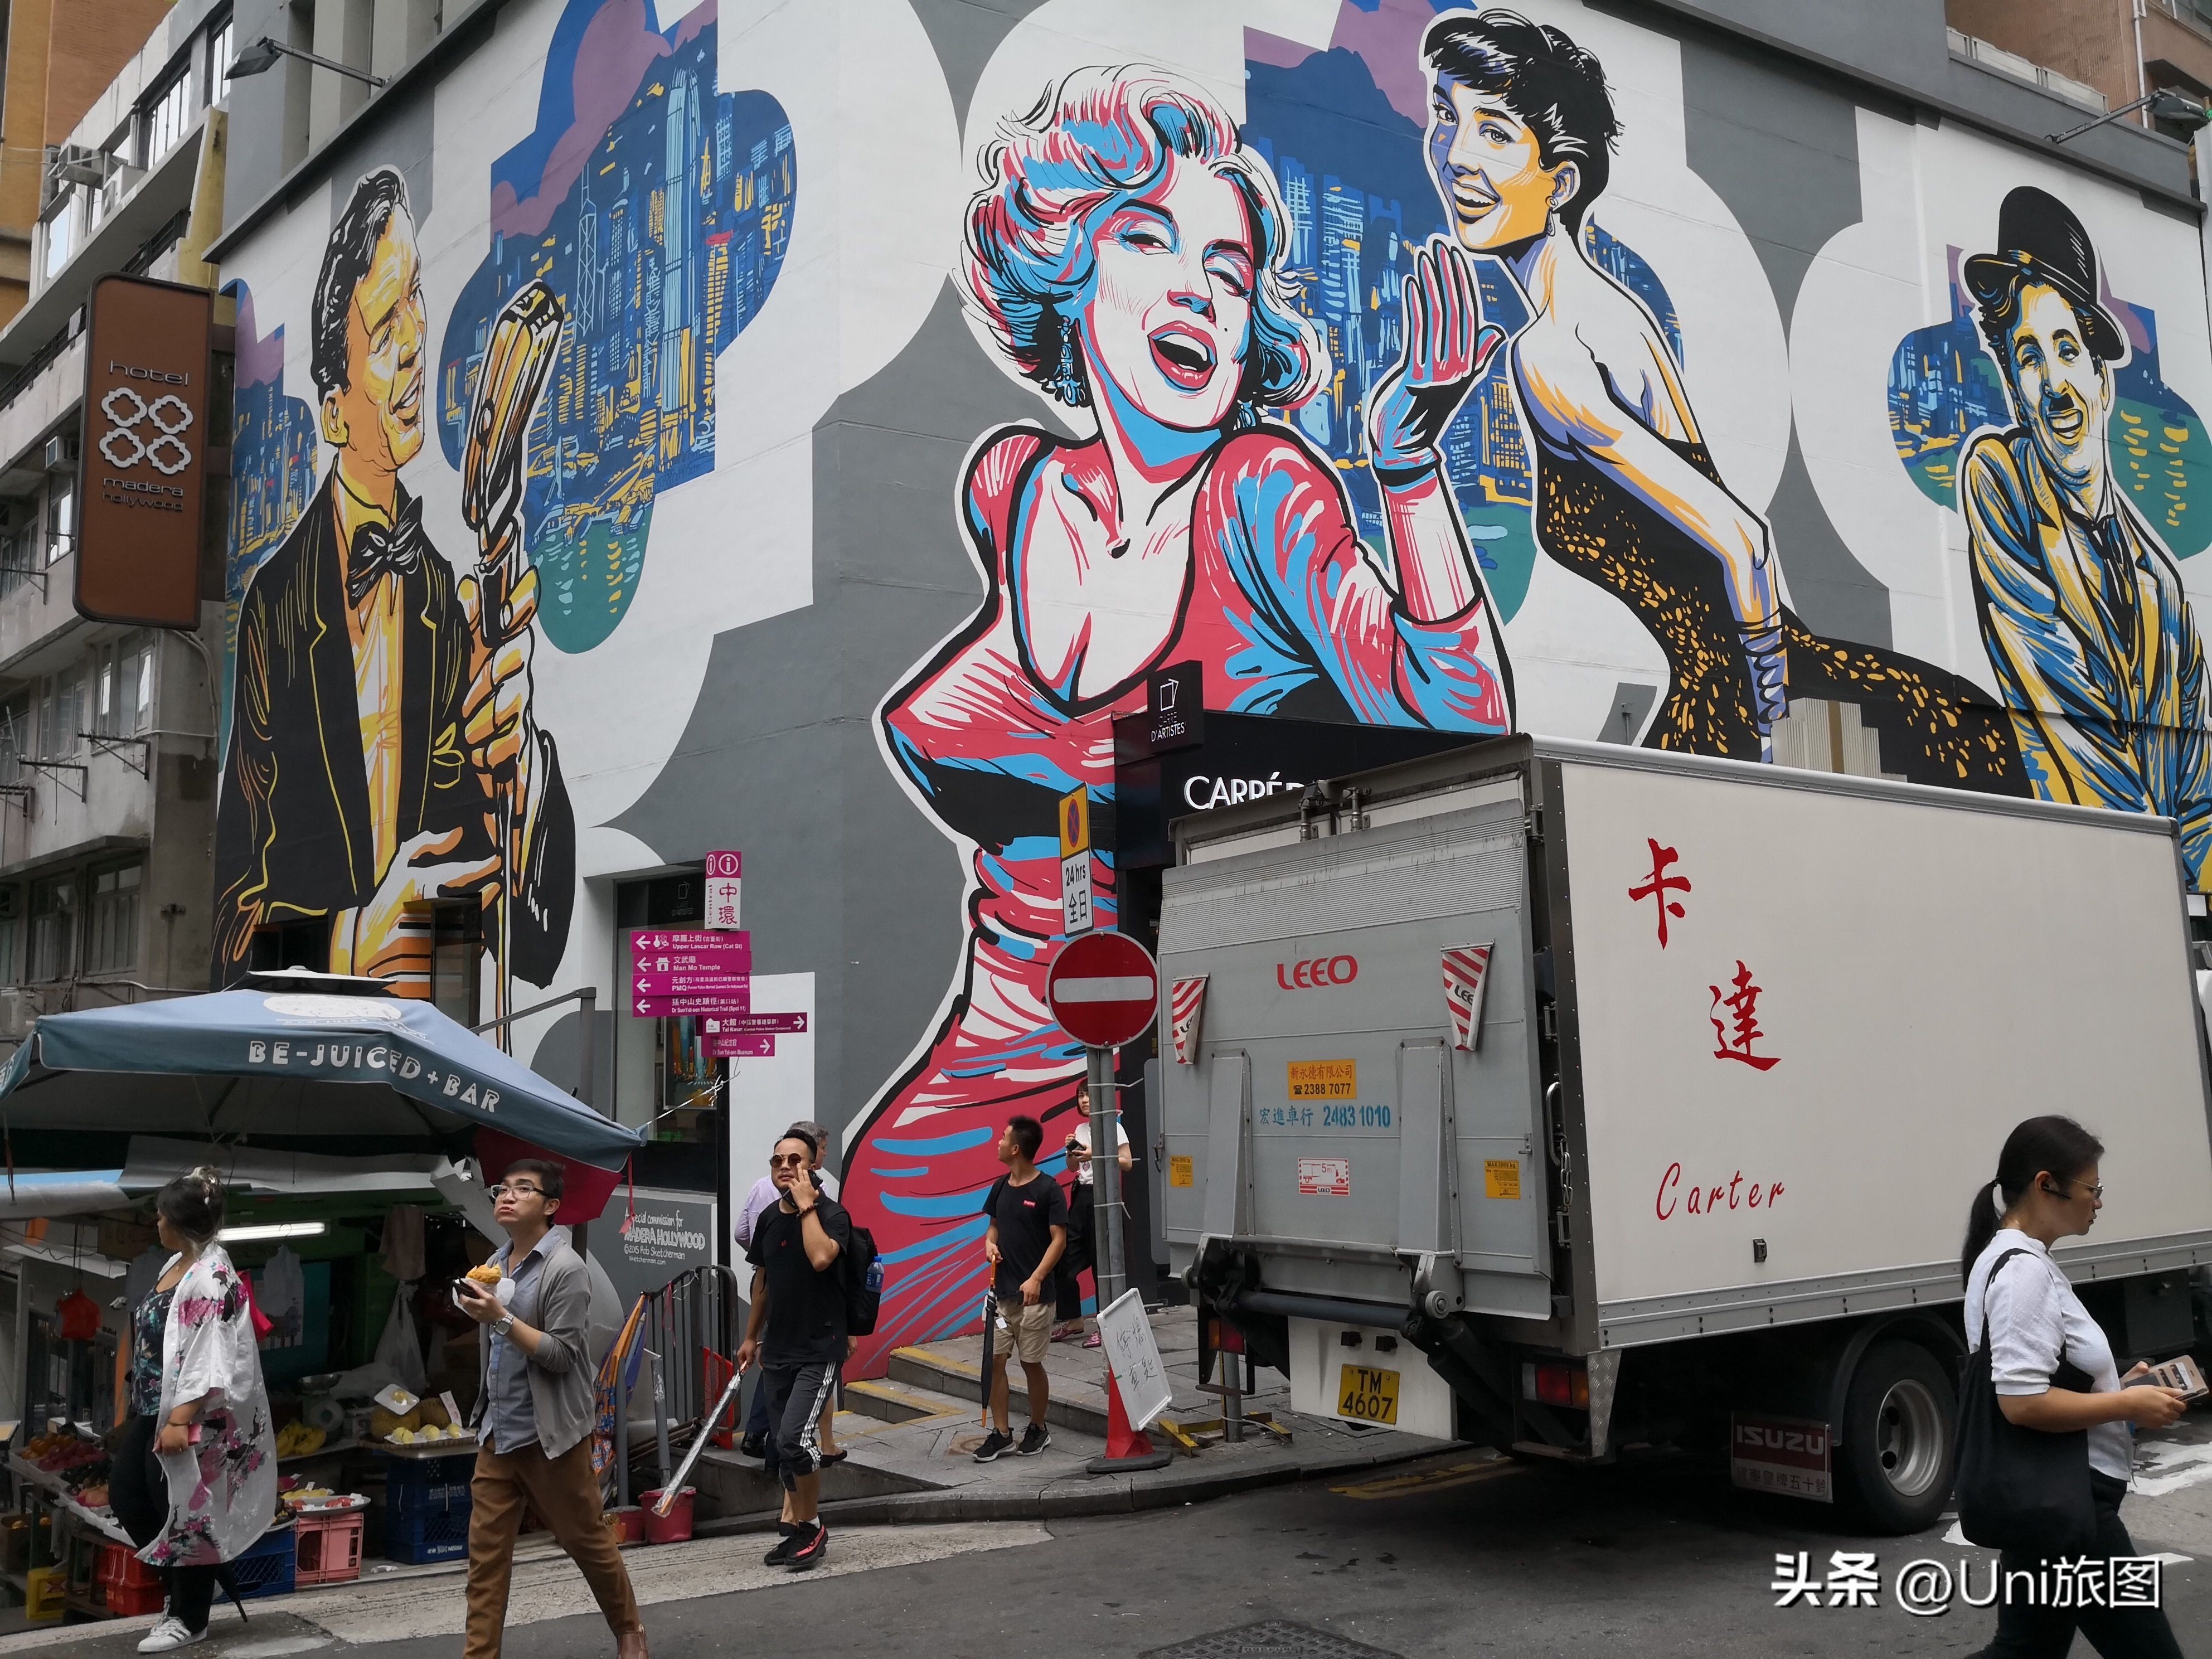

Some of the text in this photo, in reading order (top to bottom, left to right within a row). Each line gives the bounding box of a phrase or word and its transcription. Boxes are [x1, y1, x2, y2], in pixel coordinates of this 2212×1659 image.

[110, 360, 188, 385] hotel
[103, 477, 184, 497] madera
[103, 491, 183, 512] hollywood
[719, 882, 738, 925] 中環
[1068, 890, 1088, 924] 全日
[1277, 954, 1359, 990] LEEO
[722, 1018, 737, 1026] 大館
[1291, 1064, 1352, 1080] 新永德有限公司
[1304, 1083, 1351, 1095] 2388 7077
[1259, 1105, 1391, 1128] 宏進車行 2483 1010
[1656, 1162, 1785, 1221] Carter
[647, 1214, 675, 1227] commission
[675, 1210, 684, 1231] for
[624, 1226, 706, 1250] MADERA HOLLYWOOD
[640, 1245, 650, 1255] Rob
[651, 1248, 685, 1260] Sketcherman
[1357, 1369, 1382, 1394] TM
[1342, 1391, 1393, 1419] 4607
[1736, 1425, 1824, 1455] ISUZU
